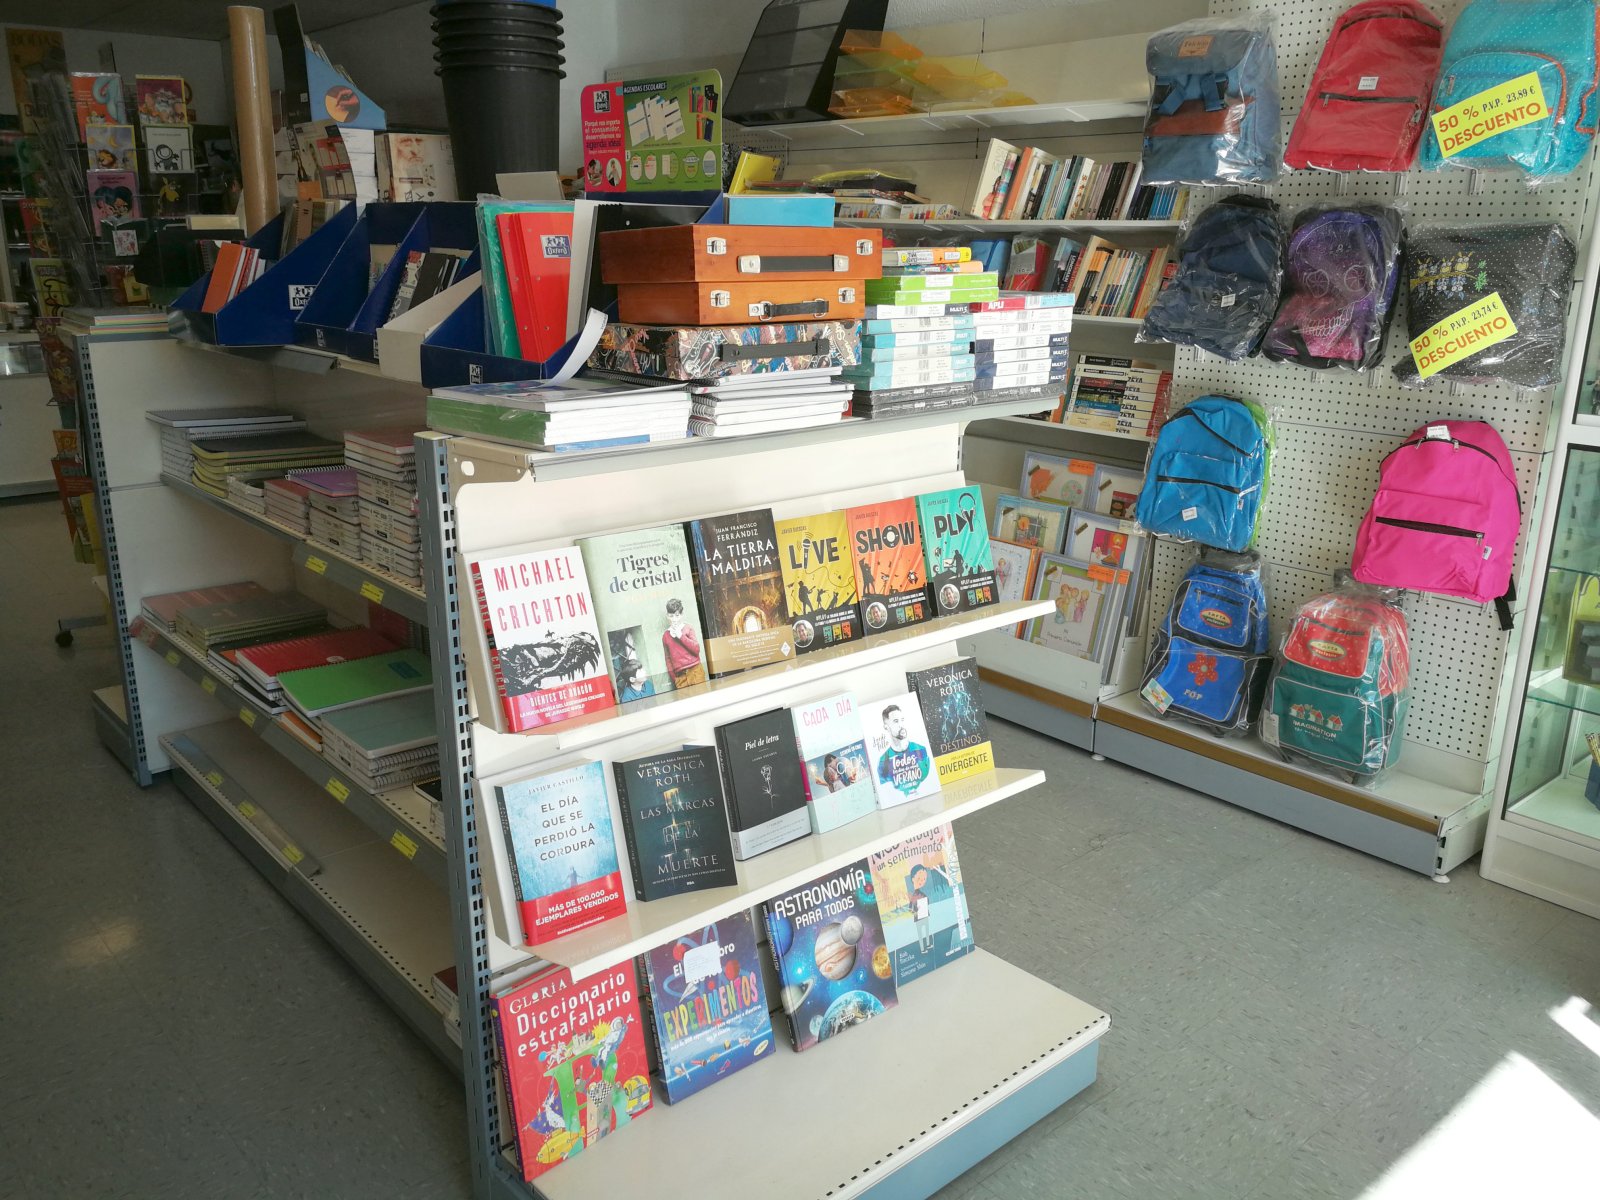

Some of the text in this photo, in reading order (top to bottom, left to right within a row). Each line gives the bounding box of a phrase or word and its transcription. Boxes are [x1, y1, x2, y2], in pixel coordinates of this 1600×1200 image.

[624, 84, 642, 94] AGENDAS
[643, 82, 666, 92] ESCOLARES
[1439, 115, 1458, 132] 50
[1443, 102, 1541, 151] DESCUENTO
[988, 301, 1004, 310] APLI
[1414, 336, 1430, 352] 50
[1419, 316, 1507, 369] DESCUENTO
[715, 522, 758, 534] JUAN FRANCISCO
[717, 528, 758, 542] FERRÁNDIZ
[856, 520, 914, 554] SHOW
[704, 538, 774, 562] LA TIERRA
[788, 537, 840, 570] LIVE
[494, 556, 575, 592] MICHAEL
[616, 552, 670, 574] Tigres
[712, 554, 772, 576] MALDITA
[610, 566, 682, 594] de cristal
[498, 592, 588, 632] CRICHTON
[926, 668, 972, 688] VERONICA
[940, 682, 964, 696] ROTH
[559, 690, 568, 700] DE
[803, 697, 852, 728] CADA DÍA
[745, 735, 779, 750] Piel de letra
[940, 733, 982, 754] DESTINOS
[637, 760, 704, 778] VERONICA
[892, 753, 917, 770] Todos
[940, 752, 988, 776] DIVERGENTE
[656, 773, 690, 786] ROTH
[892, 768, 922, 786] VERANO
[541, 796, 578, 813] EL DÍA
[640, 797, 715, 820] LAS MARCAS
[542, 810, 583, 828] QUE SE
[534, 822, 595, 846] PERDIÓ LA
[540, 838, 595, 861] CORDURA
[876, 840, 942, 872] un sentimiento
[658, 854, 718, 874] MUERTE
[548, 890, 604, 914] MÁS DE 100.000
[775, 867, 867, 920] ASTRONOMÍA
[536, 906, 582, 926] EJEMPLARES
[584, 892, 618, 910] VENDIDOS
[796, 896, 854, 930] PARA TODOS
[673, 962, 682, 976] El
[509, 978, 567, 1014] GLORIA
[516, 973, 624, 1036] Diccionario
[663, 972, 759, 1041] EXPERIMENTOS
[518, 990, 630, 1056] estrafalario
